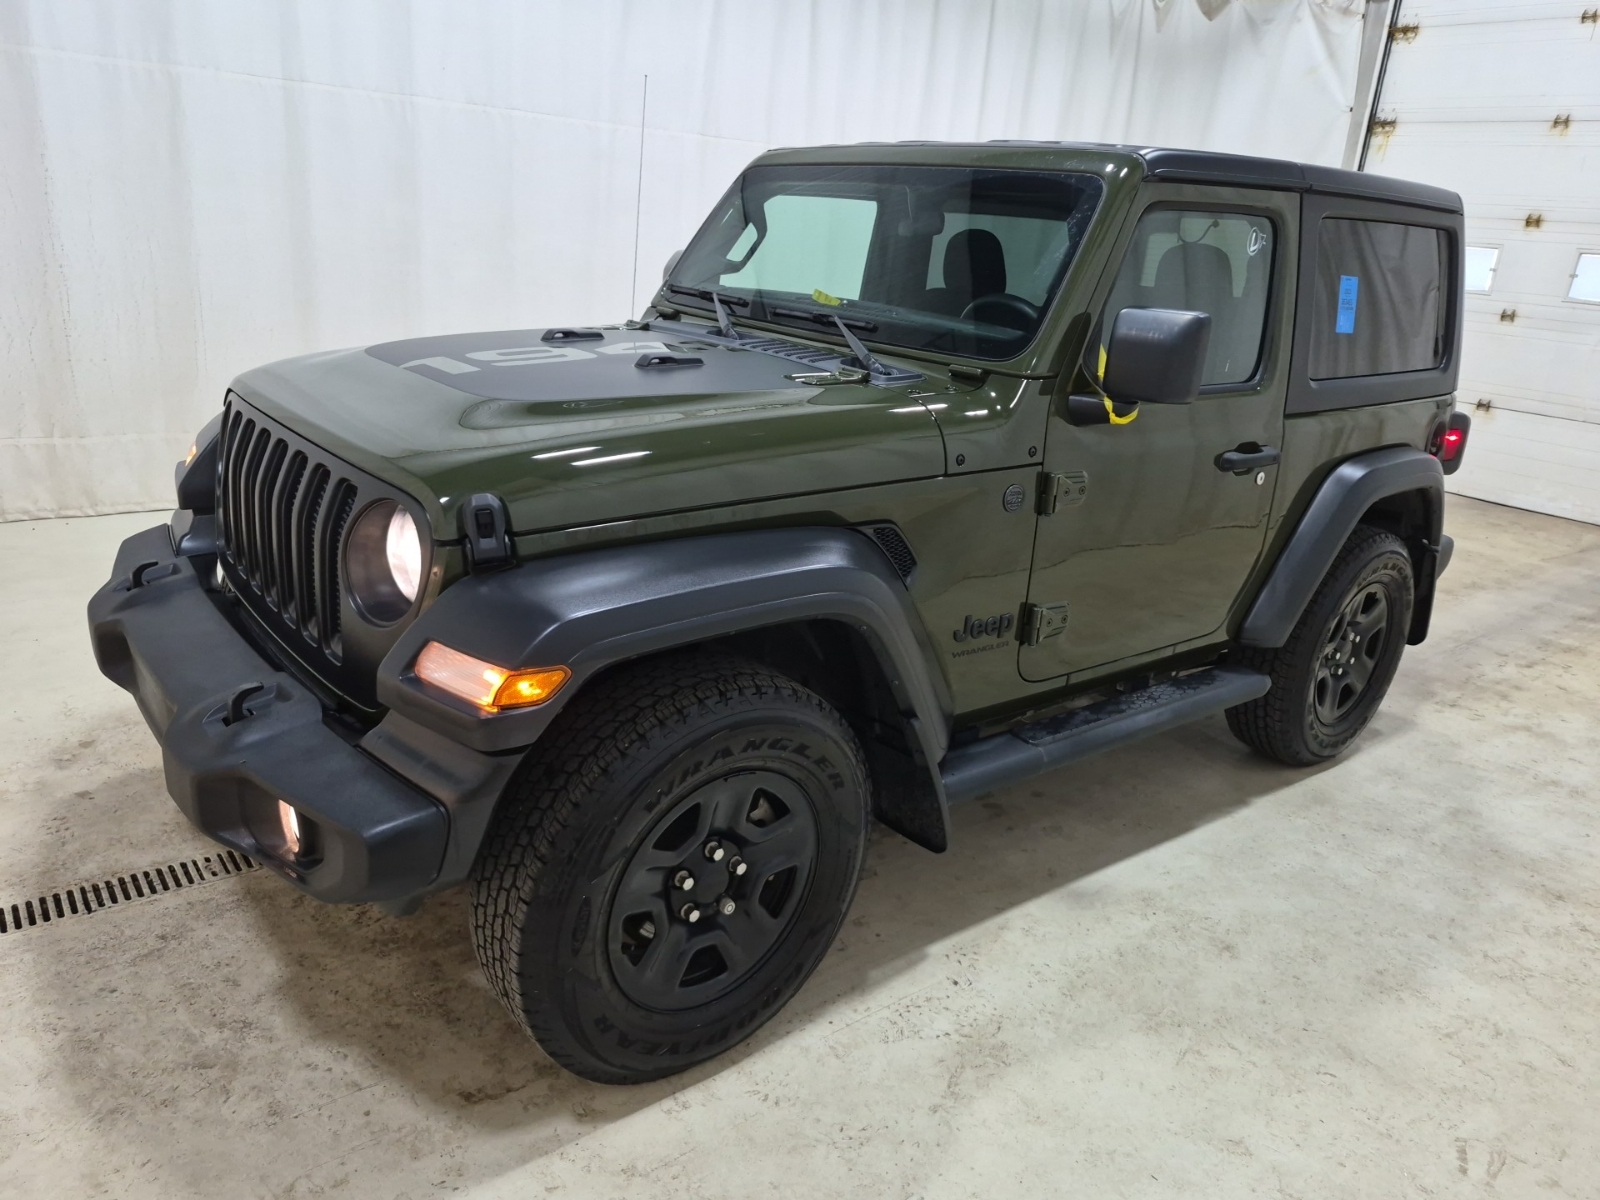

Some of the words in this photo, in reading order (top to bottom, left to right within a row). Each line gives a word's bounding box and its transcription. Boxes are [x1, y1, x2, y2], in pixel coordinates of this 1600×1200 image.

[953, 612, 1015, 643] Jeep
[951, 640, 1009, 659] WRANGLER
[643, 736, 846, 813] WRANGLER
